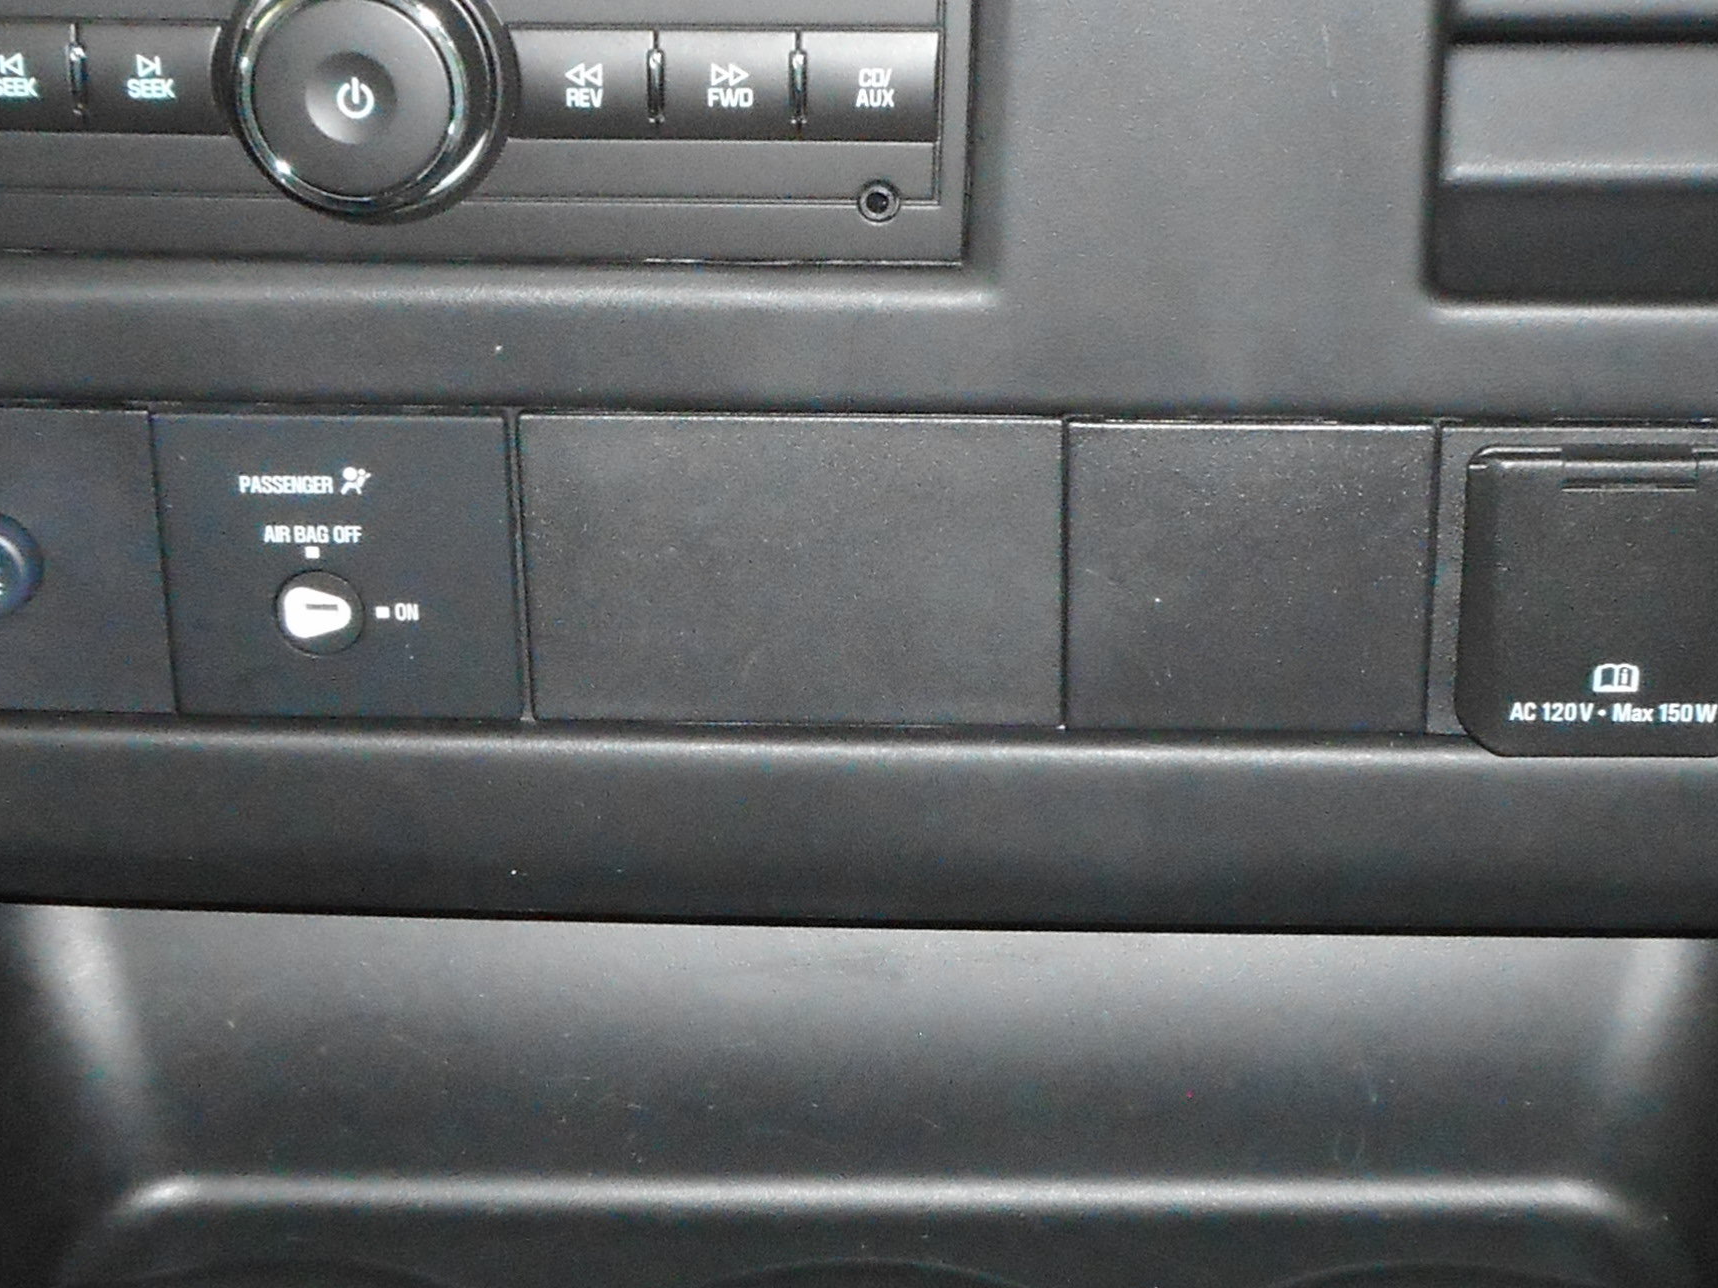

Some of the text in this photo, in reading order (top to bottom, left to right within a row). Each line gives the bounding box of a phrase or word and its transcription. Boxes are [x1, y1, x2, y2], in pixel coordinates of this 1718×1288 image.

[127, 78, 176, 99] SEEK
[566, 88, 604, 108] REV
[707, 88, 754, 109] FWD
[855, 88, 895, 109] AUX
[238, 475, 334, 494] PASSENGER
[262, 525, 363, 544] AIR BAG OFF
[394, 602, 420, 622] ON
[1509, 701, 1537, 722] AC
[1611, 702, 1654, 722] Max
